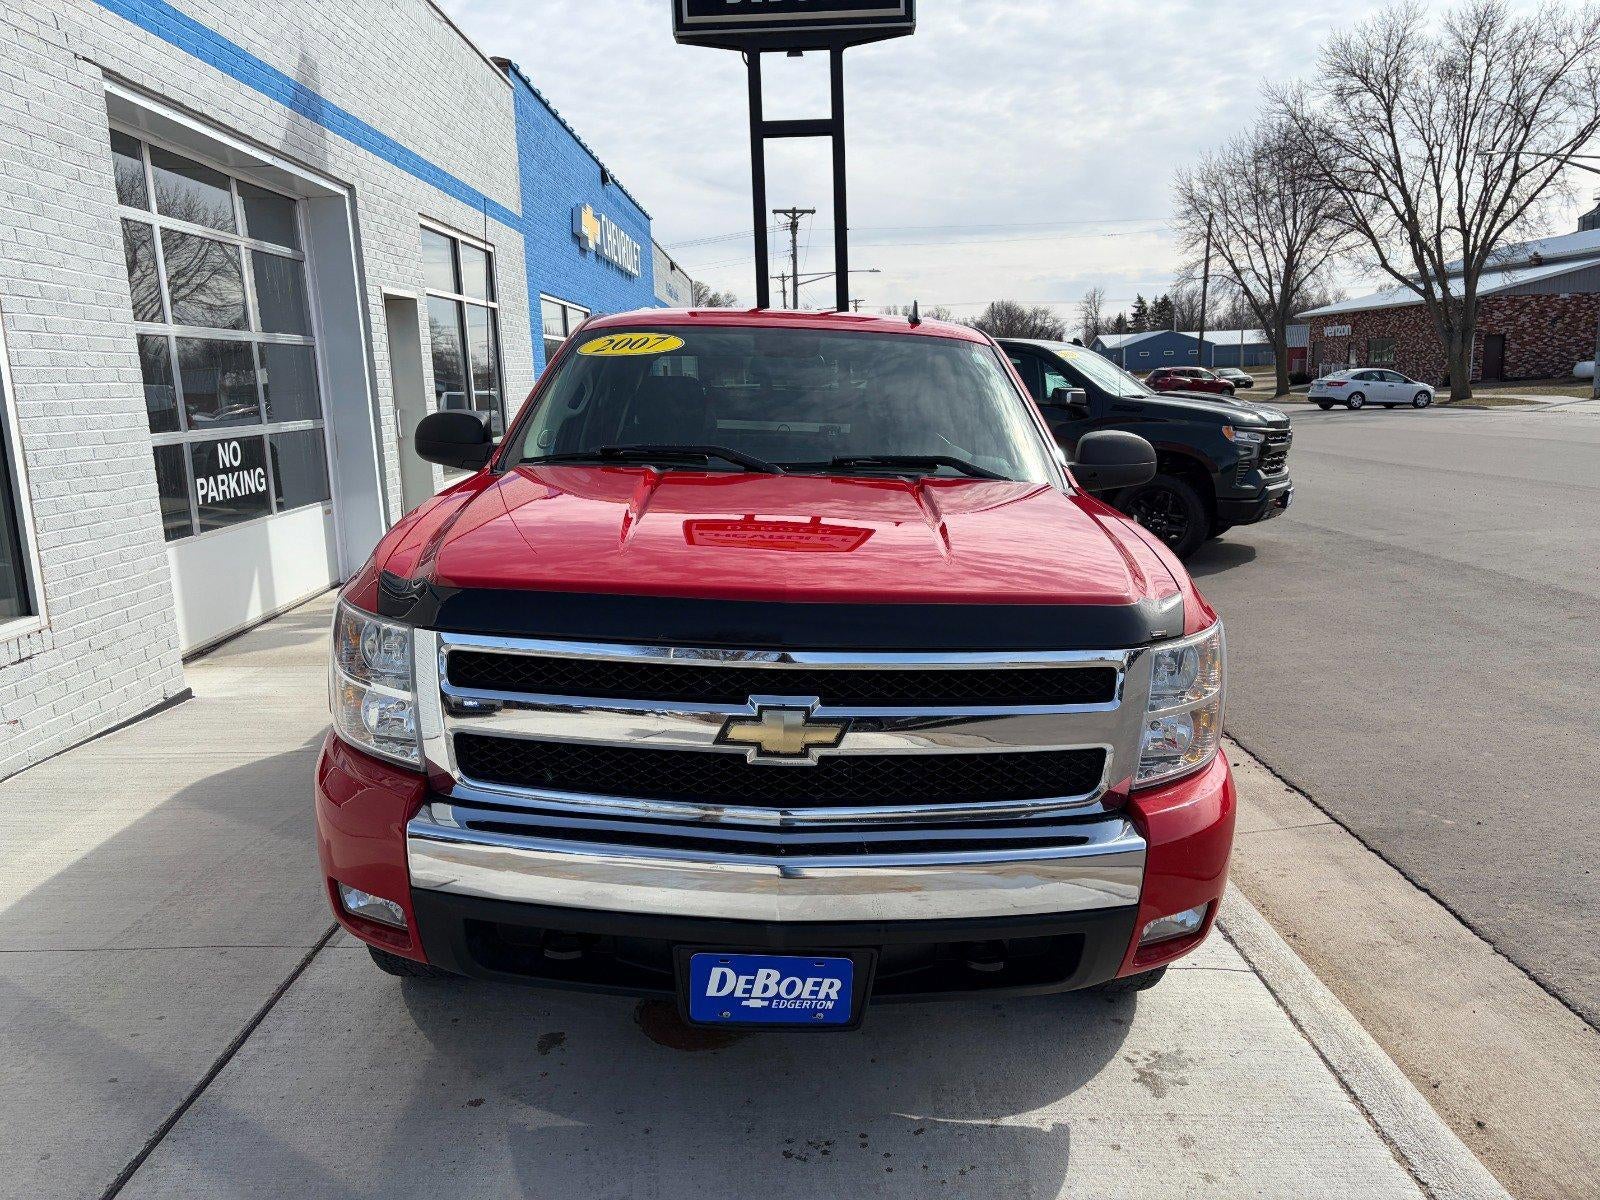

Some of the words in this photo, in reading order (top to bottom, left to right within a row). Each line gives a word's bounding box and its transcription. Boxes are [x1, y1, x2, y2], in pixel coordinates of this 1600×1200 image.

[601, 213, 641, 277] CHEVROLET
[1324, 322, 1351, 337] verizon
[593, 336, 669, 352] 2007
[217, 440, 242, 469] NO
[196, 467, 267, 506] PARKING
[772, 999, 834, 1010] EDGERTON
